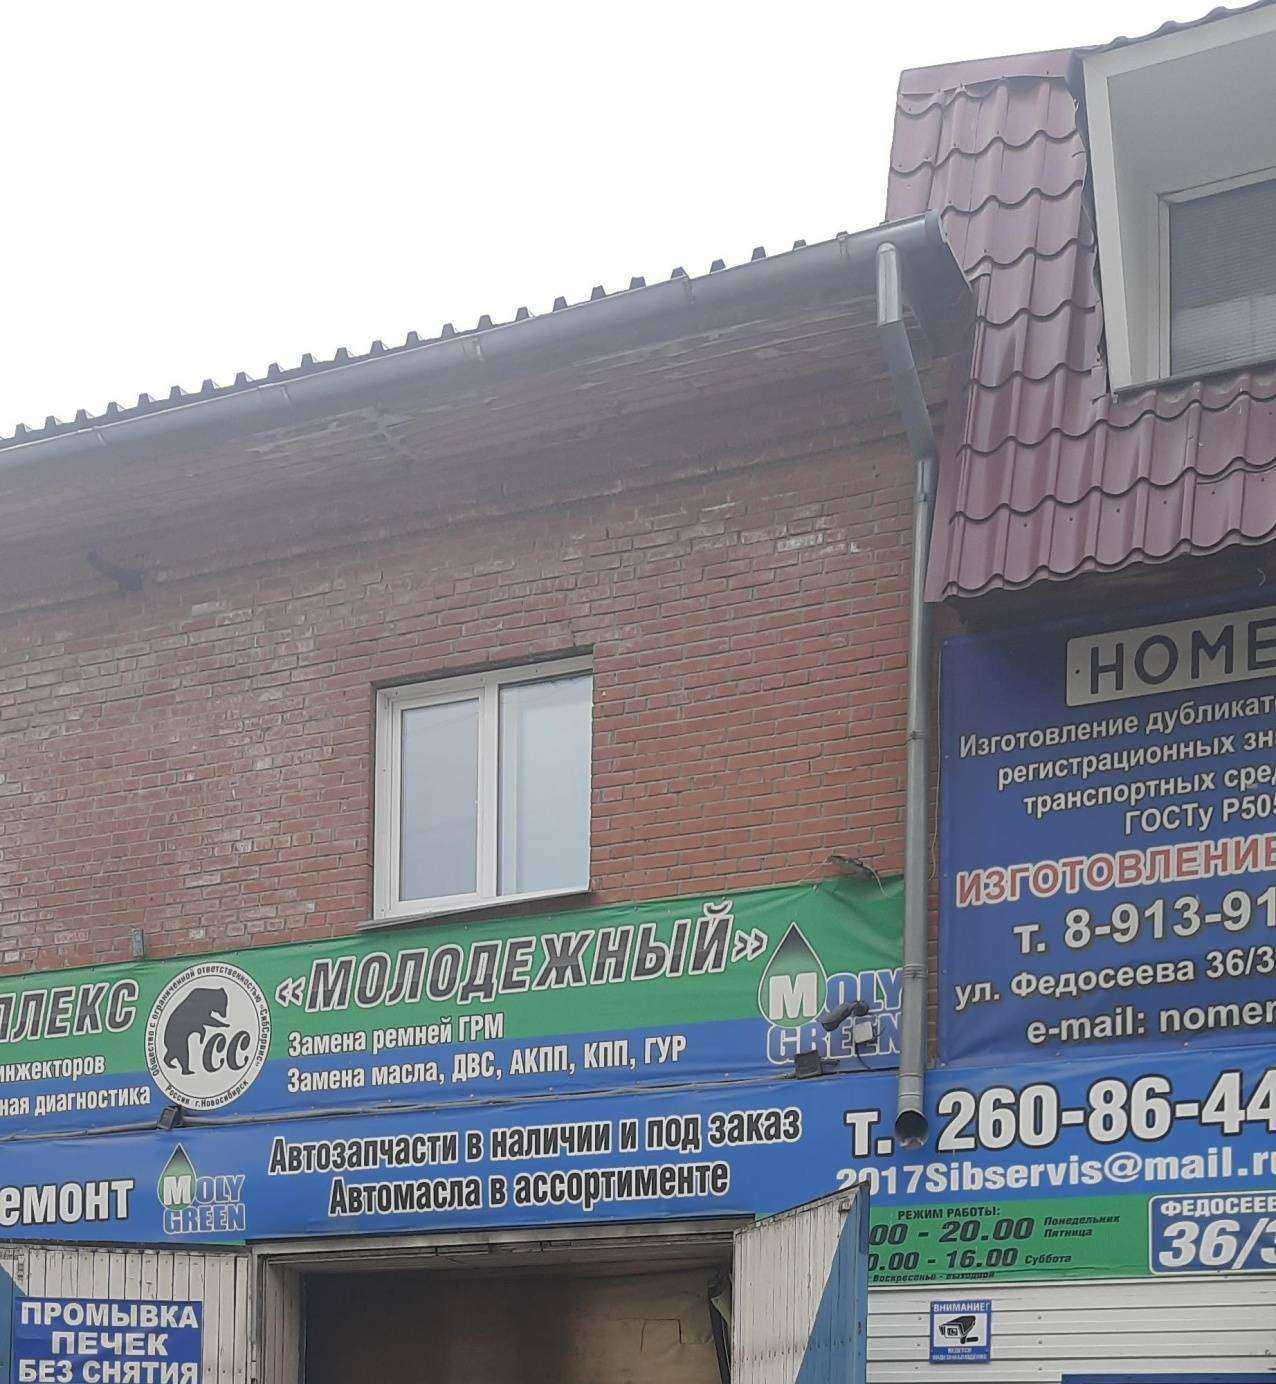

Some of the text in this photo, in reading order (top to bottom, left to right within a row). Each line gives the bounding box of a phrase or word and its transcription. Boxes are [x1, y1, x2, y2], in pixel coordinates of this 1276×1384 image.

[1090, 618, 1276, 695] НОМЕ
[959, 694, 1276, 758] Изготовление дубликат
[998, 729, 1276, 792] регистрационных зн
[1023, 771, 1216, 819] транспортных
[1124, 802, 1214, 836] ГОСТу
[1012, 886, 1276, 955] т. 8-913-91
[275, 900, 768, 1013] «МОЛОДЕЖНЫЙ»
[769, 967, 904, 1020] MOLY
[954, 981, 1001, 1012] ул.
[1010, 958, 1195, 999] Федосеева
[288, 1013, 505, 1058] Замена ремней ГРМ
[1026, 1005, 1147, 1046] e-mail:
[287, 1035, 688, 1093] Замена масла, ДВС, АКПП, КПП, ГУР
[34, 1084, 151, 1116] диагностика
[936, 1068, 1276, 1154] 260-86-44
[268, 1106, 803, 1176] Автозапчасти в наличии и под заказ
[163, 1174, 246, 1206] MOLY
[328, 1160, 731, 1217] Автомасла в ассортименте
[836, 1146, 1276, 1196] 2017Sibservis@mail.r
[0, 1178, 135, 1226] емонт
[163, 1203, 247, 1235] GREEN
[898, 1206, 1001, 1220] РЕЖИМ РАБОТЫ:
[1043, 1215, 1121, 1227] Понедельник
[938, 1217, 1035, 1243] 20.00
[1043, 1228, 1094, 1239] Пятница
[946, 1247, 1019, 1269] 16.00
[1024, 1254, 1073, 1266] Суббота
[21, 1301, 199, 1328] ПРОМЫВКА
[51, 1331, 169, 1356] ПЕЧЕК
[18, 1359, 198, 1384] БЕЗ СНЯТИЯ
